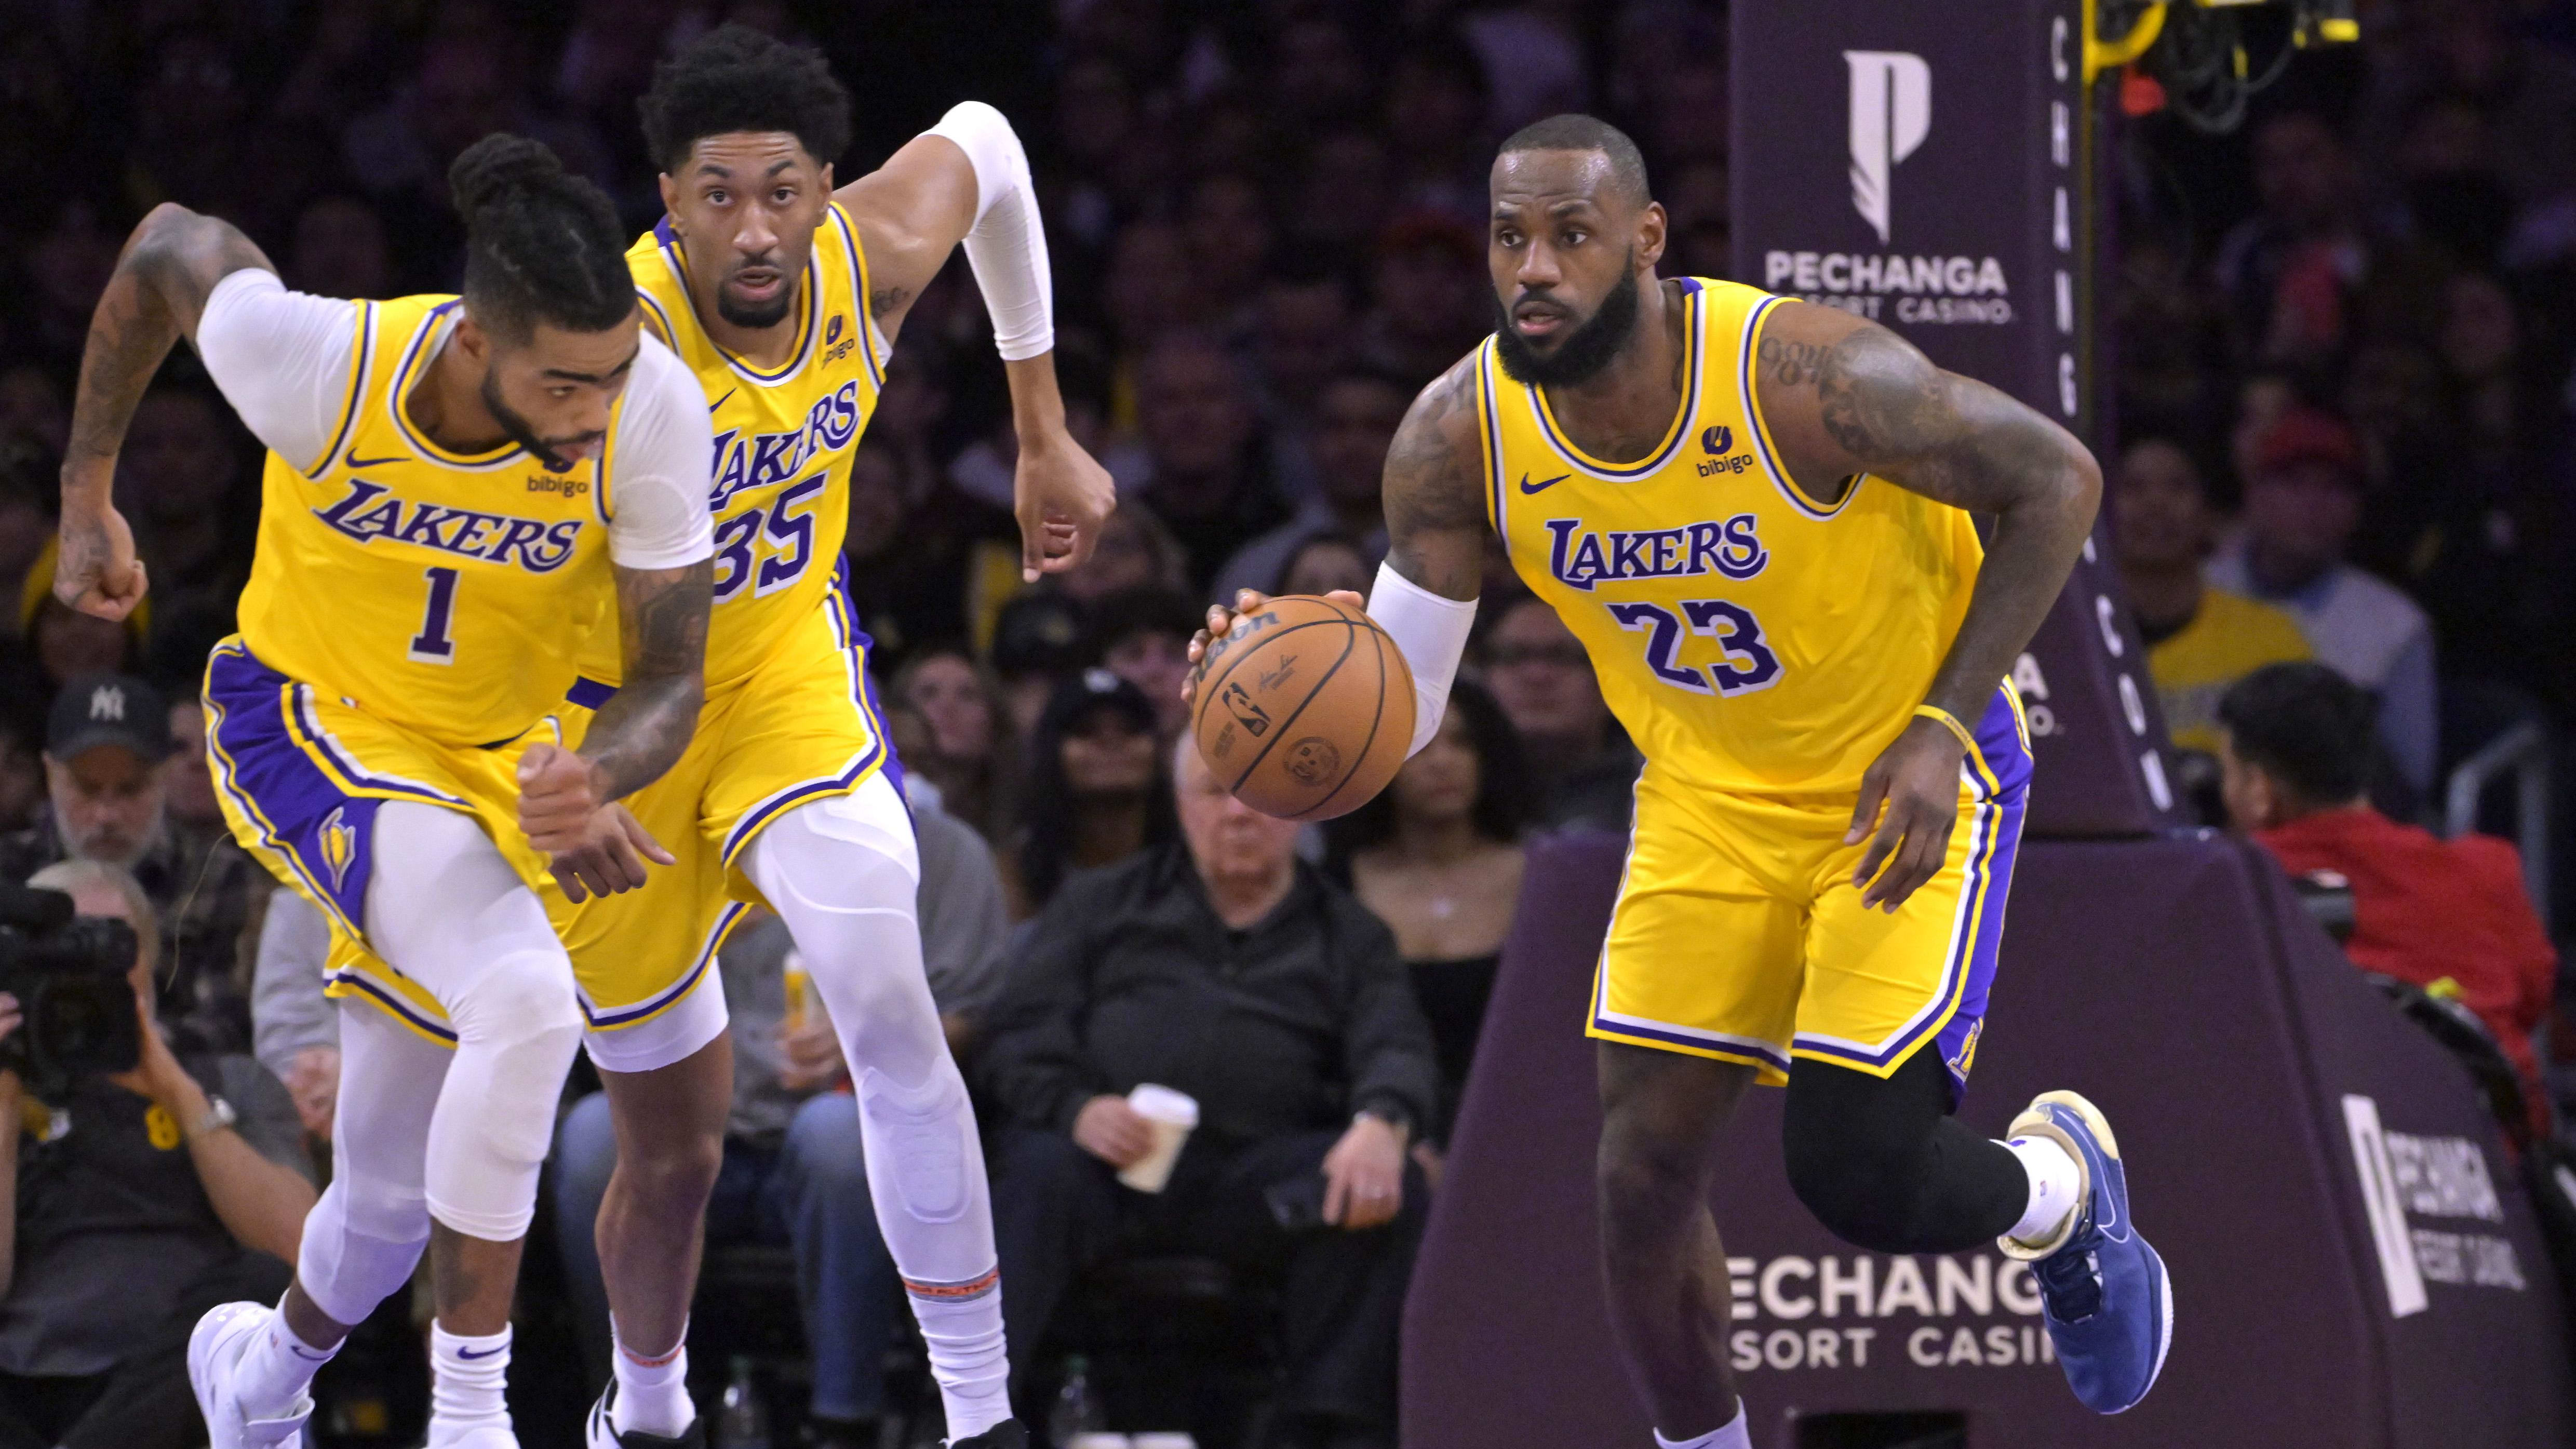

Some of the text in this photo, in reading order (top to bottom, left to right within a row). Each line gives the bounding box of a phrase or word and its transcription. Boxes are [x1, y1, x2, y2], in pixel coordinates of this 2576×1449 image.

[1766, 250, 2008, 295] PECHANGA
[708, 379, 861, 513] LAKERS
[1696, 453, 1753, 478] bibigo
[312, 477, 584, 574] LAKERS
[527, 476, 588, 497] bibigo
[713, 469, 830, 604] 35
[1545, 513, 1770, 592] LAKERS
[406, 566, 460, 666] 1
[1603, 599, 1786, 698] 23
[1726, 1255, 2044, 1320] ECHANG
[1731, 1326, 2057, 1371] SORT CASI
